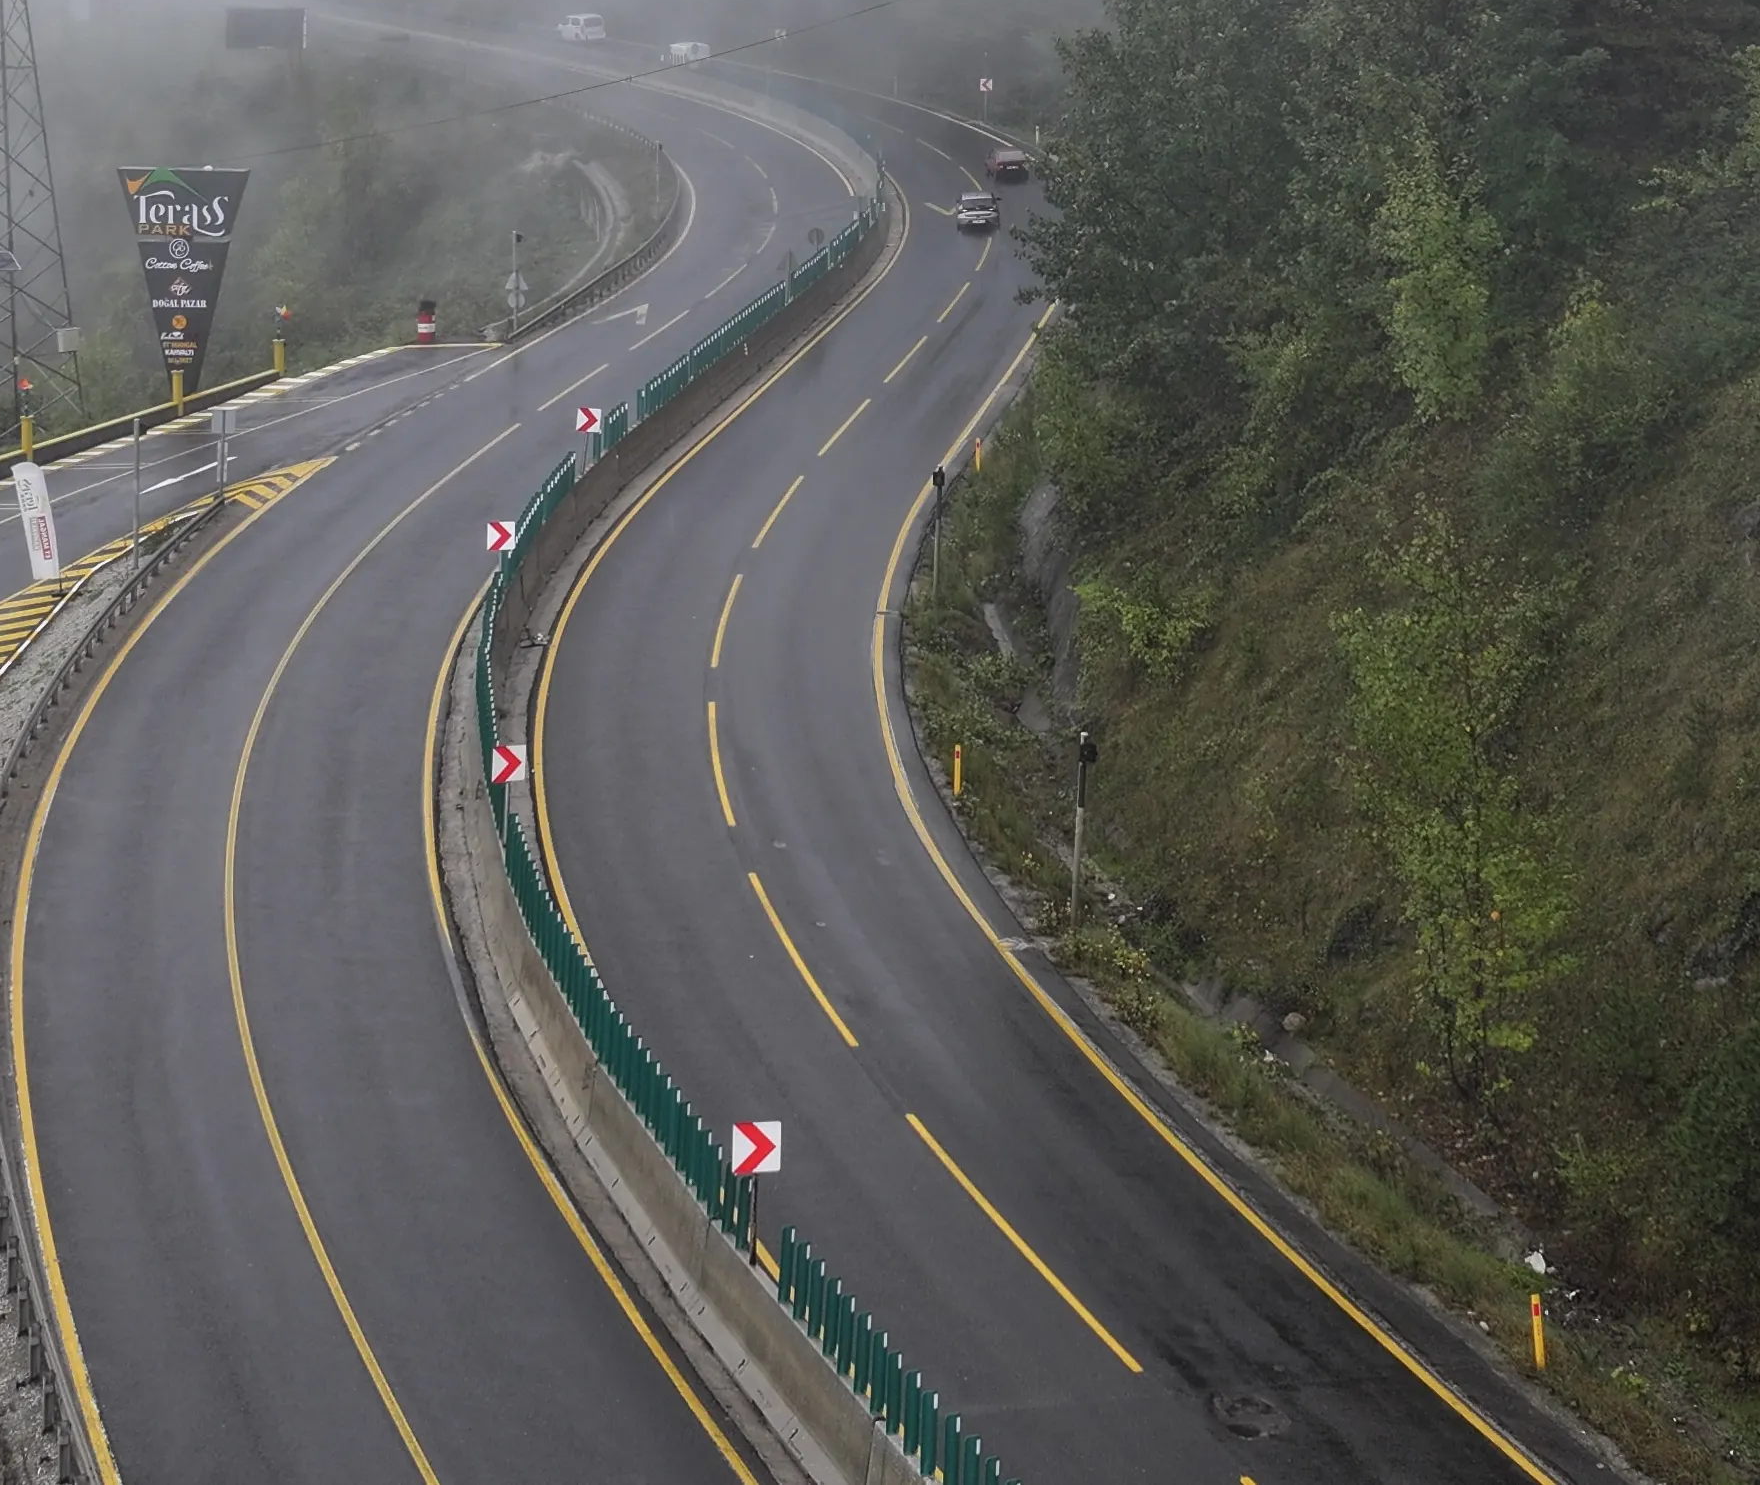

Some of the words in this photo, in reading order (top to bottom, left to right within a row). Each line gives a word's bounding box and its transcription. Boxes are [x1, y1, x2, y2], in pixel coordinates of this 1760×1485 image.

[138, 224, 191, 236] PARK
[145, 257, 178, 270] Cotton
[152, 297, 179, 308] DOĞAL
[180, 299, 207, 308] PAZAR
